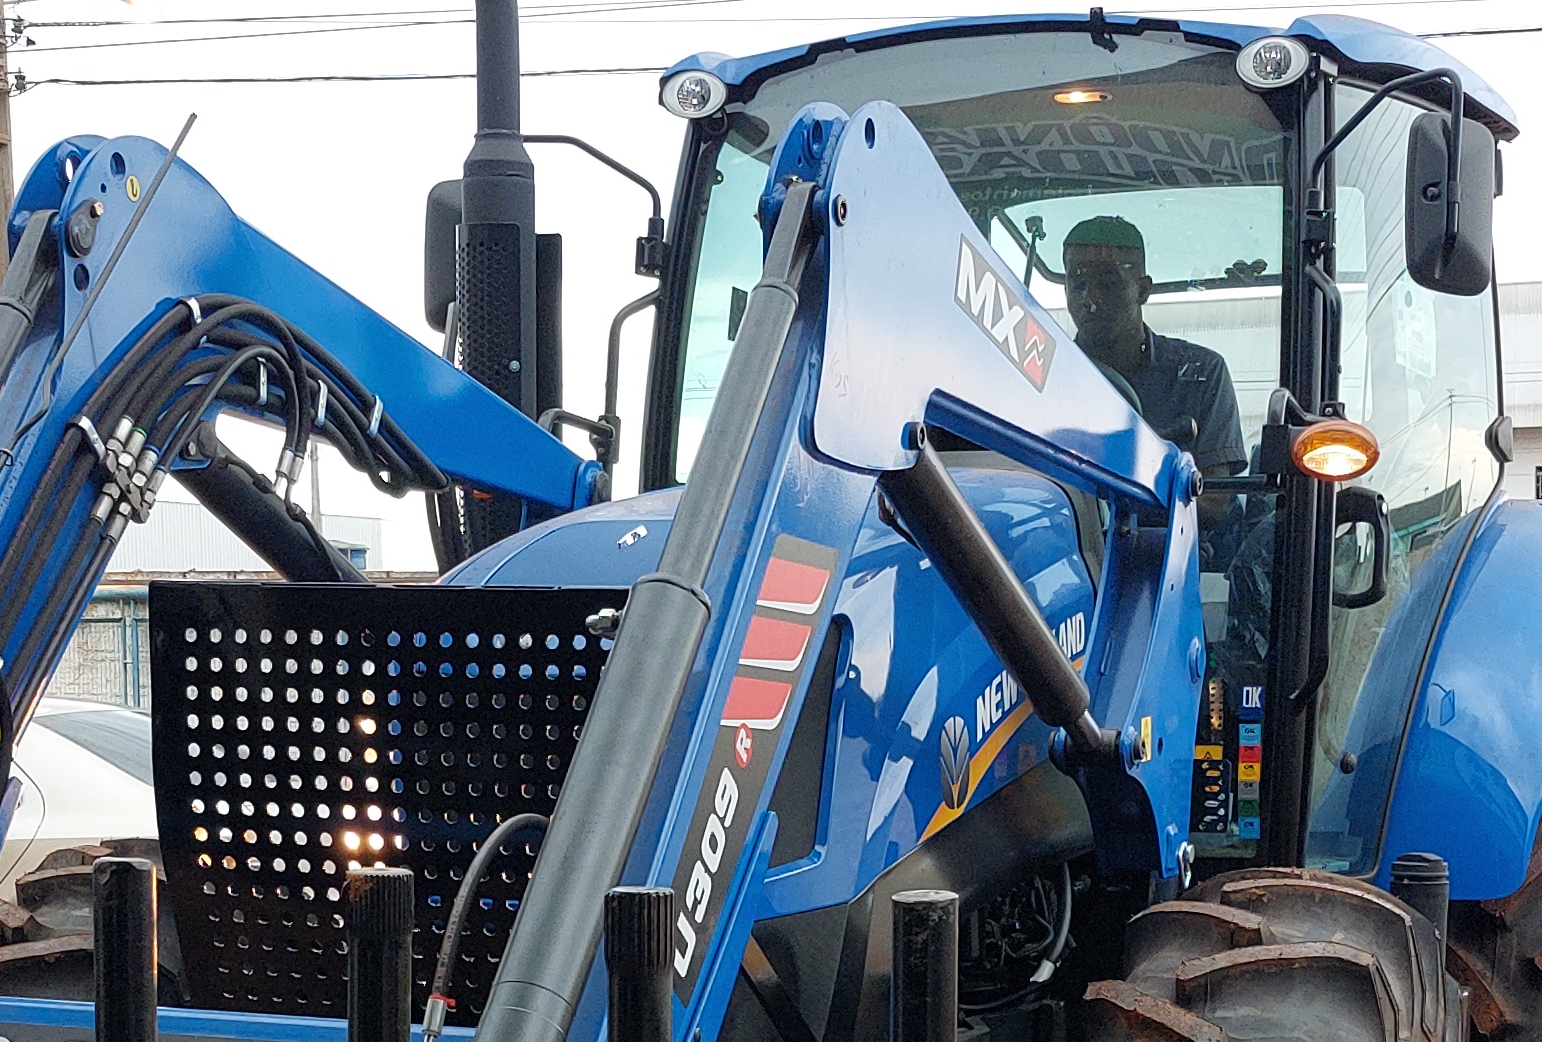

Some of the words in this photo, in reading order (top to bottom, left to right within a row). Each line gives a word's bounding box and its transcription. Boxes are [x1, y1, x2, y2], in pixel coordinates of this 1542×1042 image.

[957, 242, 1025, 363] MX
[977, 669, 1018, 743] NEW
[1242, 686, 1262, 708] OK
[673, 766, 739, 978] U309
